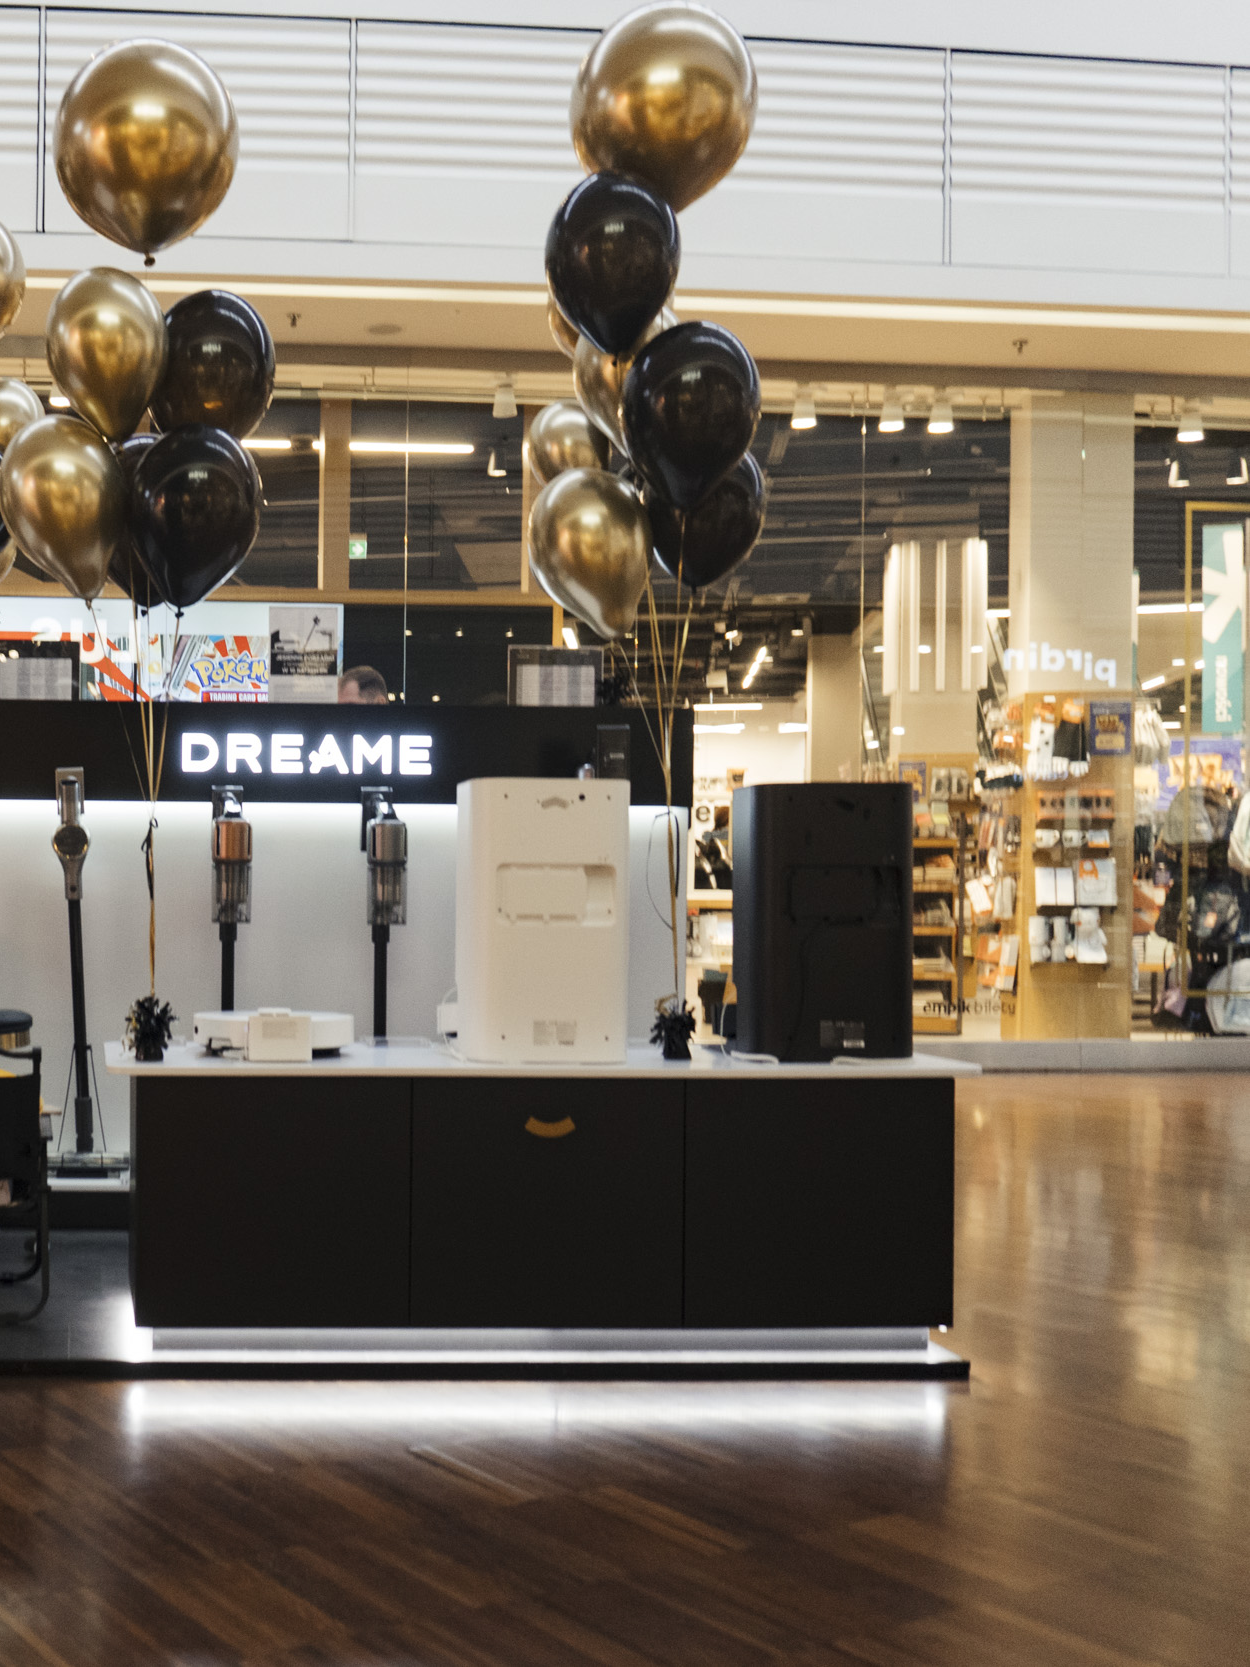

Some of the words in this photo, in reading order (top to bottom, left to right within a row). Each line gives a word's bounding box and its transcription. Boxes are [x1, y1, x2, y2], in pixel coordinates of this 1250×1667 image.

[209, 692, 238, 702] TRADING
[239, 692, 254, 702] CARD
[180, 732, 433, 776] DREAME
[923, 997, 970, 1015] empik
